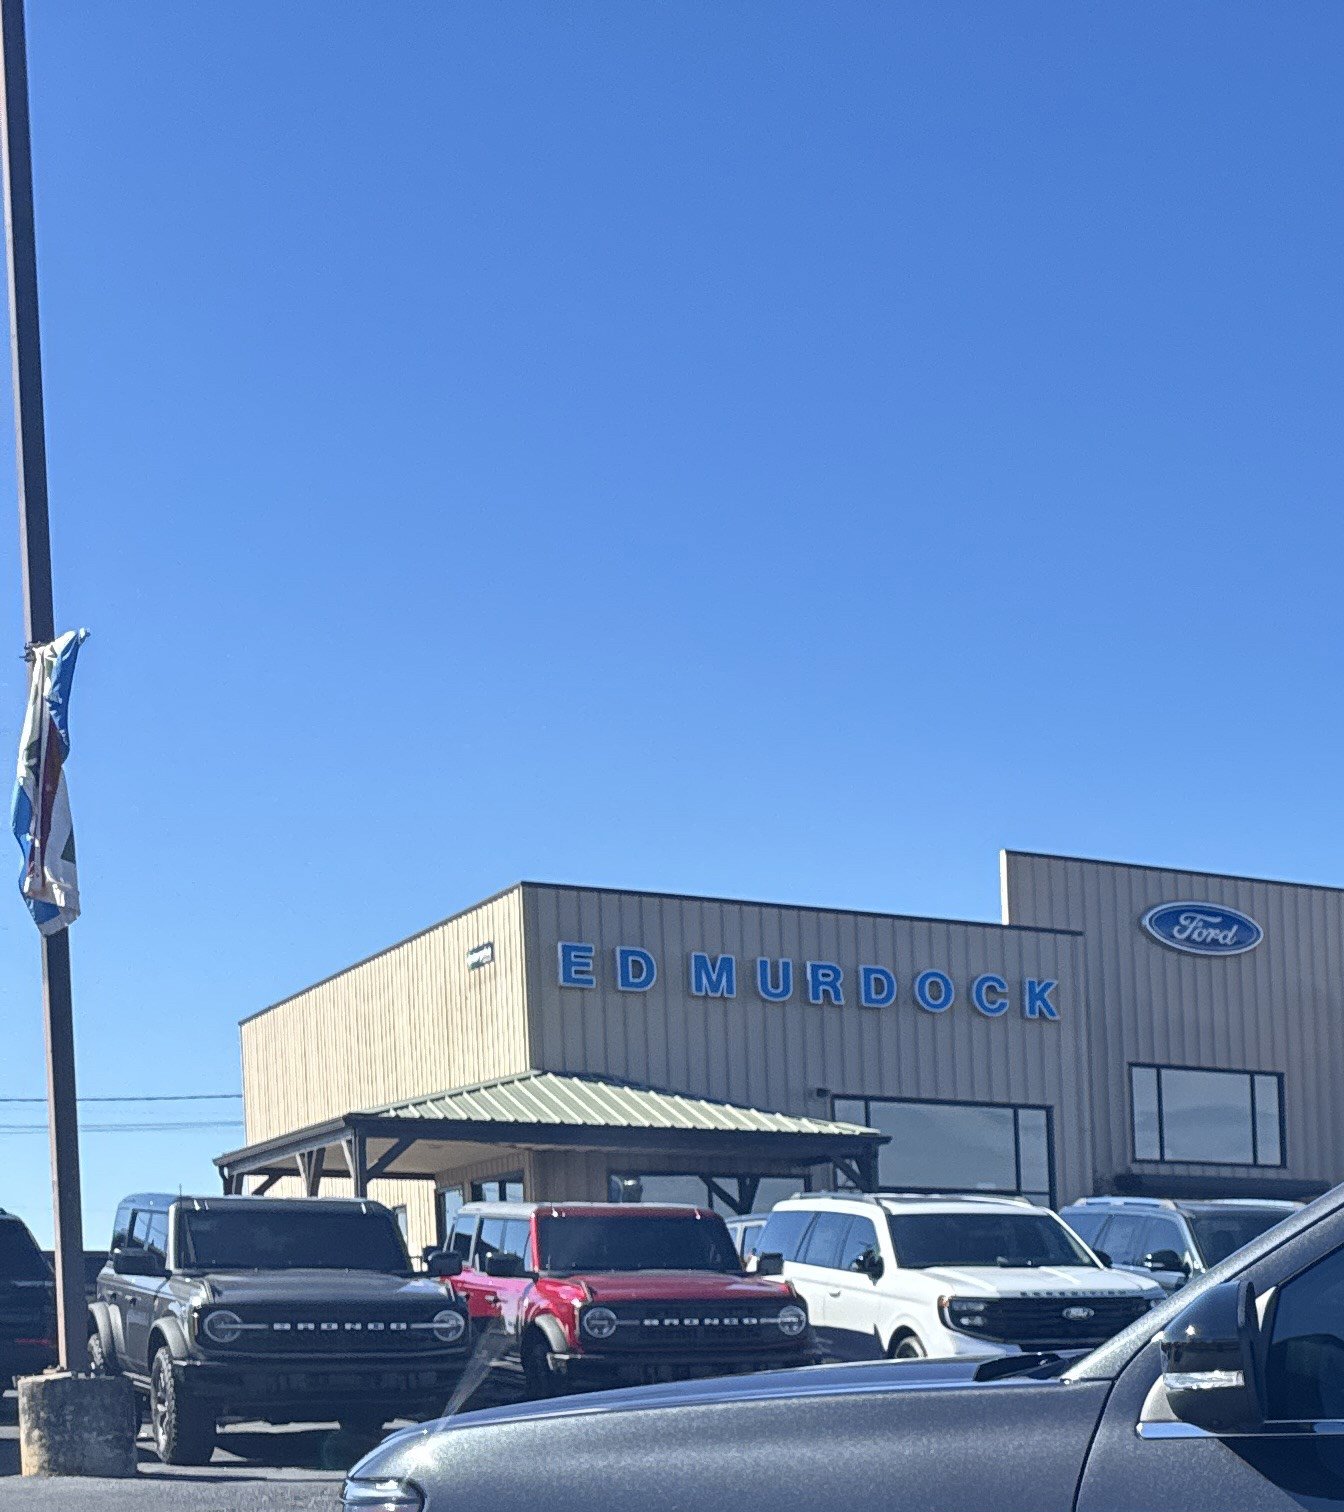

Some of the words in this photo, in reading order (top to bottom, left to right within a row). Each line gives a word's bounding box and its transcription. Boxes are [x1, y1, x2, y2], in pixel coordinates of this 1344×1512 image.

[1172, 911, 1239, 946] Ford
[557, 941, 657, 993] ED
[690, 951, 1062, 1021] MURDOCK
[272, 1321, 408, 1331] BRONCO
